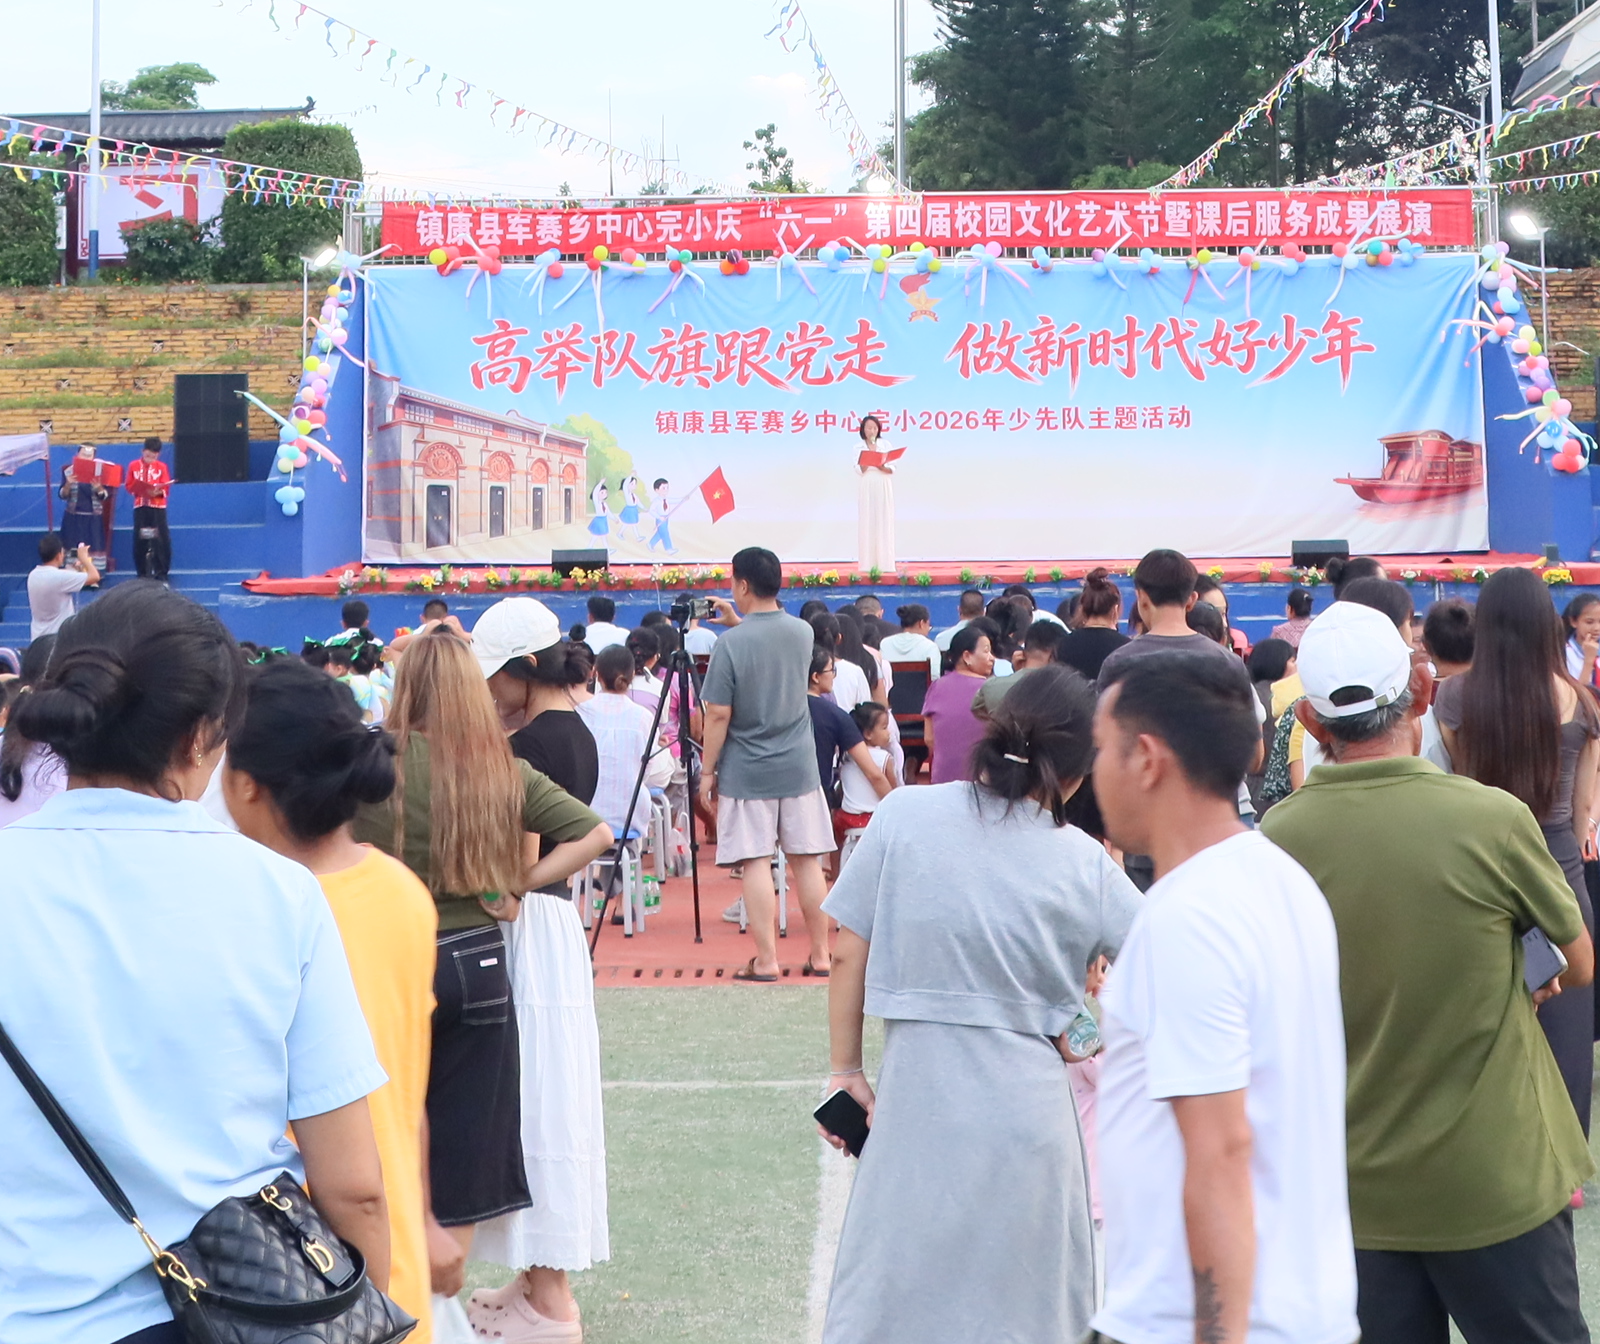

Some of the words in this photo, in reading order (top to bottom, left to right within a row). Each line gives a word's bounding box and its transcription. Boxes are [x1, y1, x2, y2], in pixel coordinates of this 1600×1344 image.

[470, 319, 916, 402] 高举队旗跟党走
[943, 311, 1376, 397] 做新时代好少年
